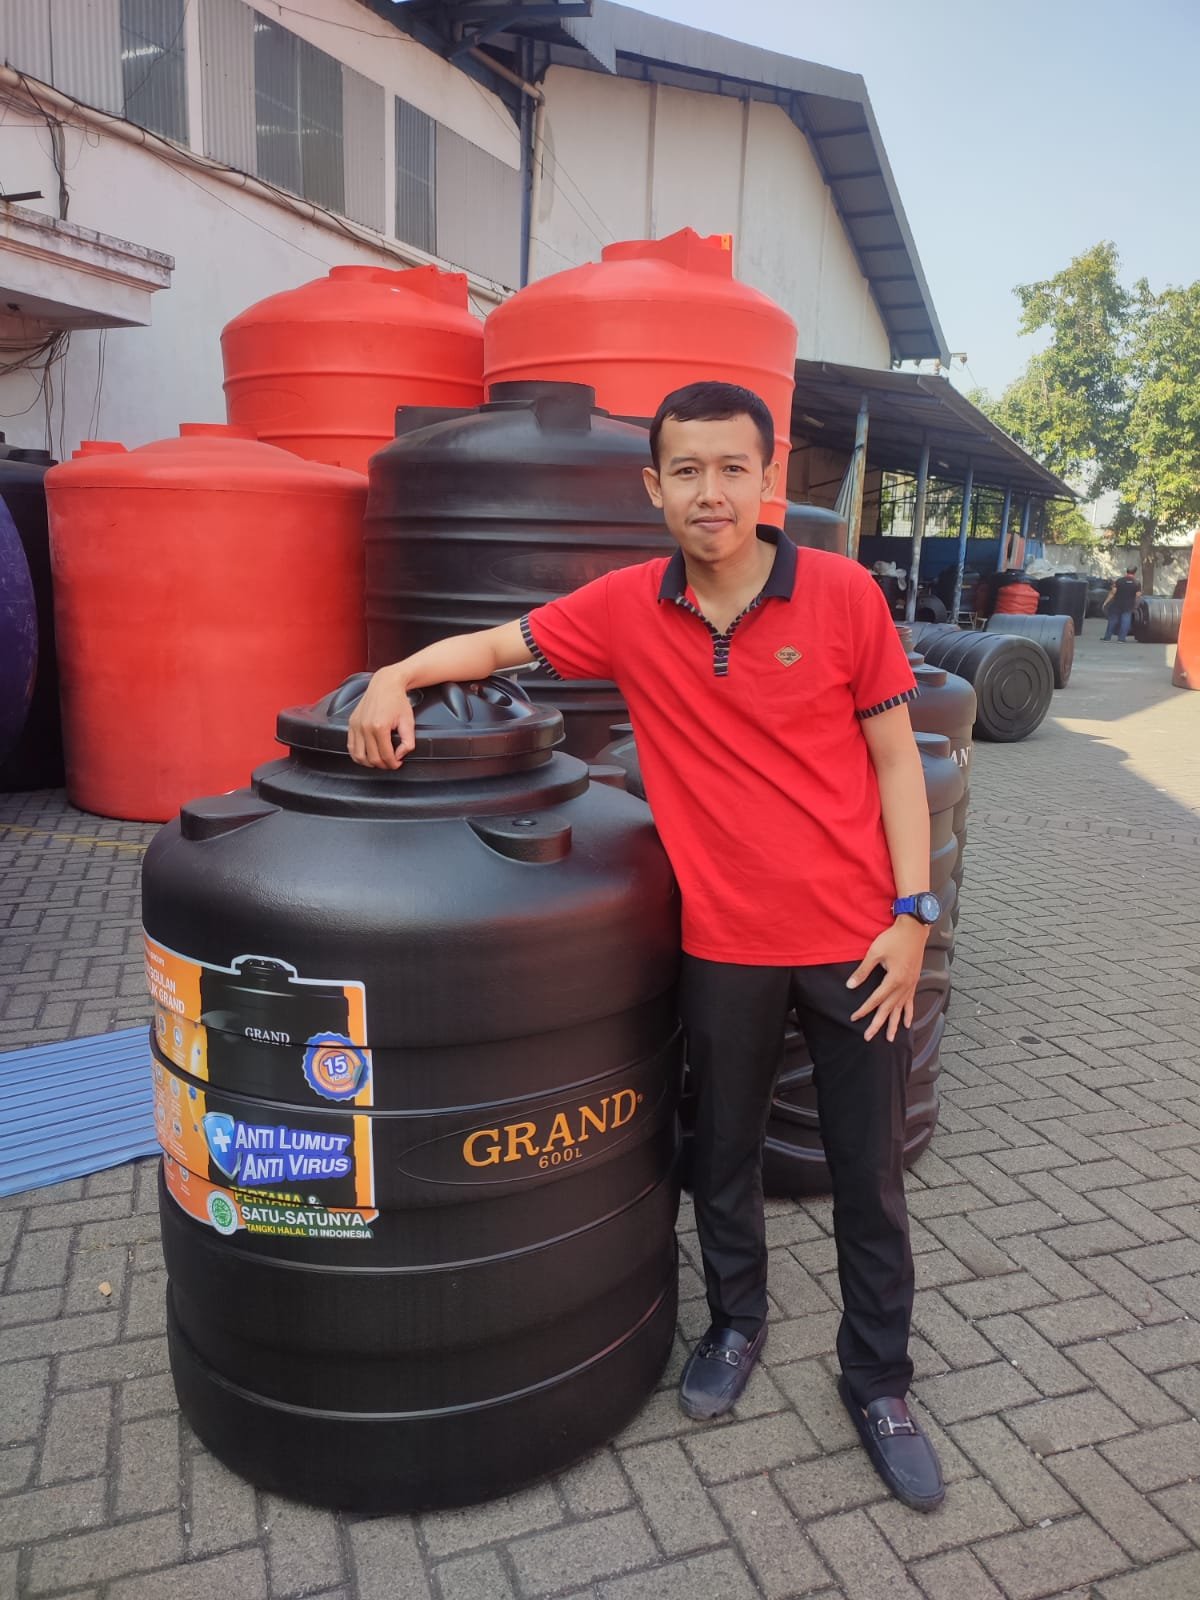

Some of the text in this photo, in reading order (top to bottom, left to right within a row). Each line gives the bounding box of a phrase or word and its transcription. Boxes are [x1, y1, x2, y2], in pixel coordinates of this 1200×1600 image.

[158, 988, 185, 1014] GRAND
[244, 1027, 291, 1044] GRAND
[323, 1055, 348, 1076] 15
[235, 1123, 348, 1152] ANTI LUMUT
[462, 1088, 638, 1167] GRAND
[242, 1153, 349, 1181] ANTI VIRUS
[539, 1147, 583, 1169] 600L
[229, 1186, 324, 1210] PERTAMA &
[241, 1206, 365, 1227] SATU-SATUNYA
[246, 1223, 372, 1239] TANGKI HALAL DI INDONESIA
